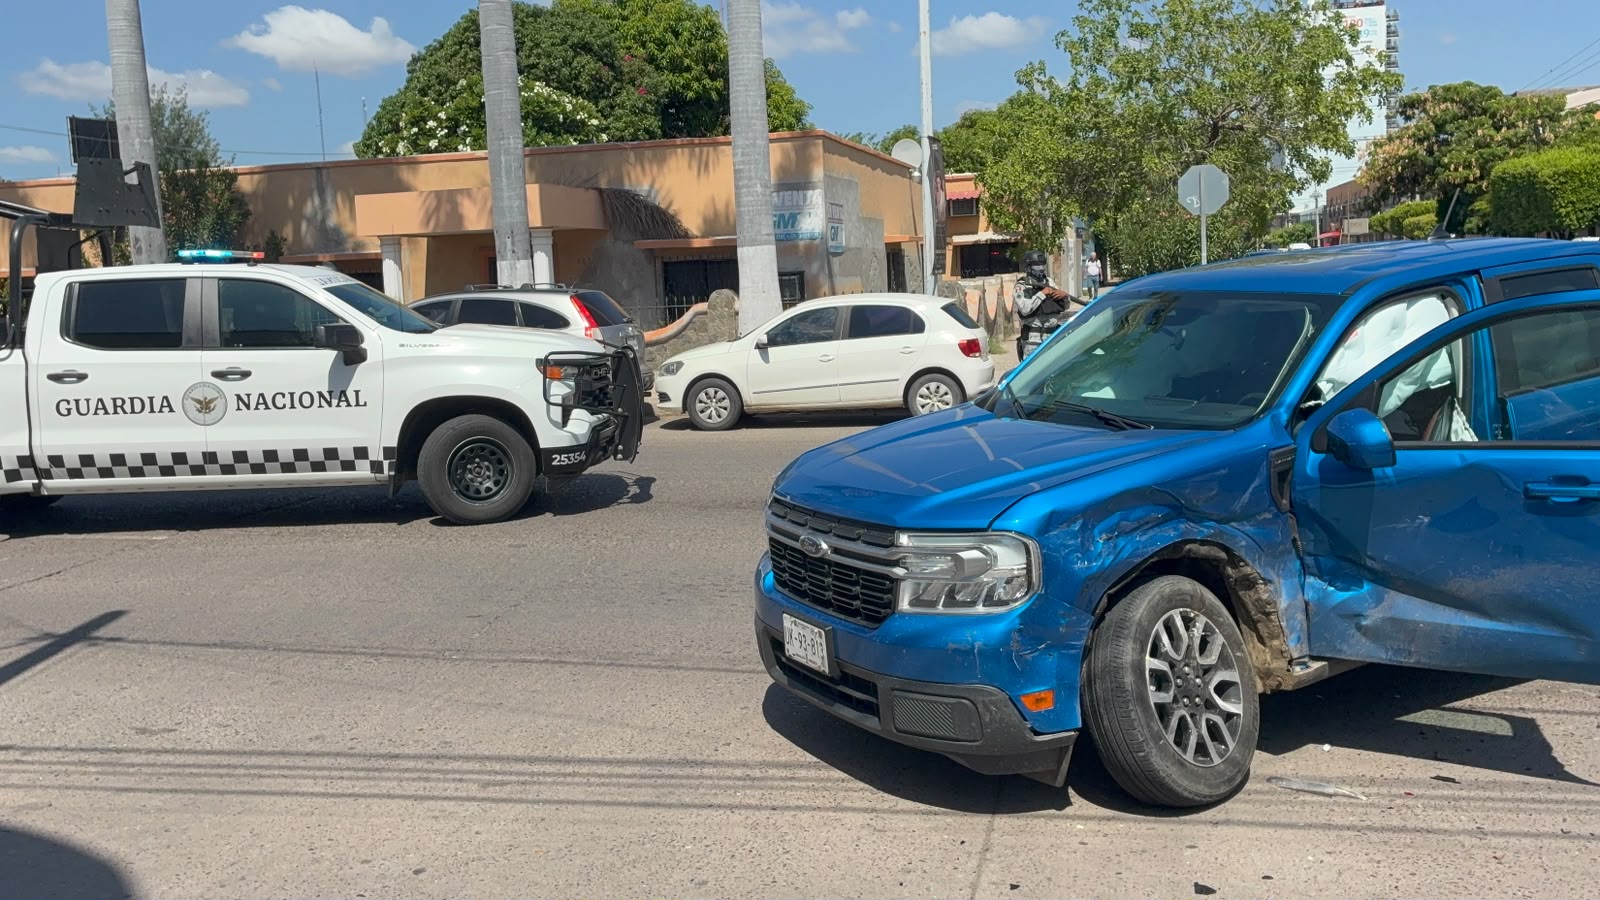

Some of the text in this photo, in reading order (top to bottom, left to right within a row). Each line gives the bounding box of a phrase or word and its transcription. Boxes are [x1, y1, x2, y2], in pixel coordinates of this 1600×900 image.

[55, 395, 176, 417] GUARDIA
[234, 389, 368, 412] NACIONAL
[551, 450, 587, 466] 25354
